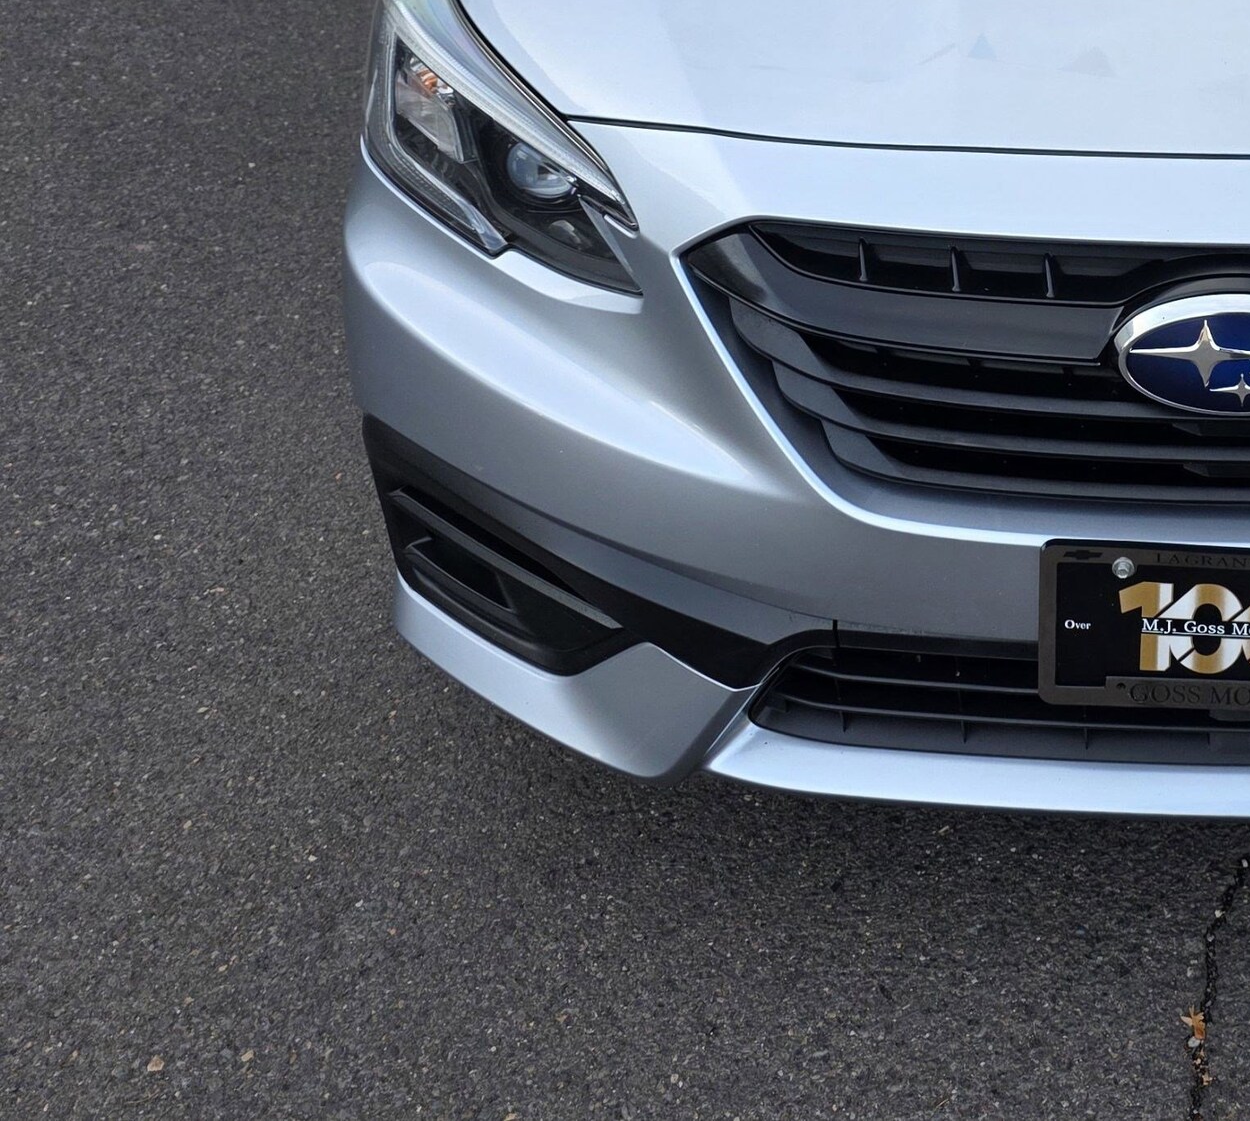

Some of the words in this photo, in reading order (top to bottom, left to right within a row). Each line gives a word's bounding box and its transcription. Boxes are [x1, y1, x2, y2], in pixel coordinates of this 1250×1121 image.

[1064, 619, 1092, 630] Over
[1141, 618, 1177, 634] M.J.
[1183, 620, 1226, 635] Goss
[1129, 683, 1200, 704] GOSS
